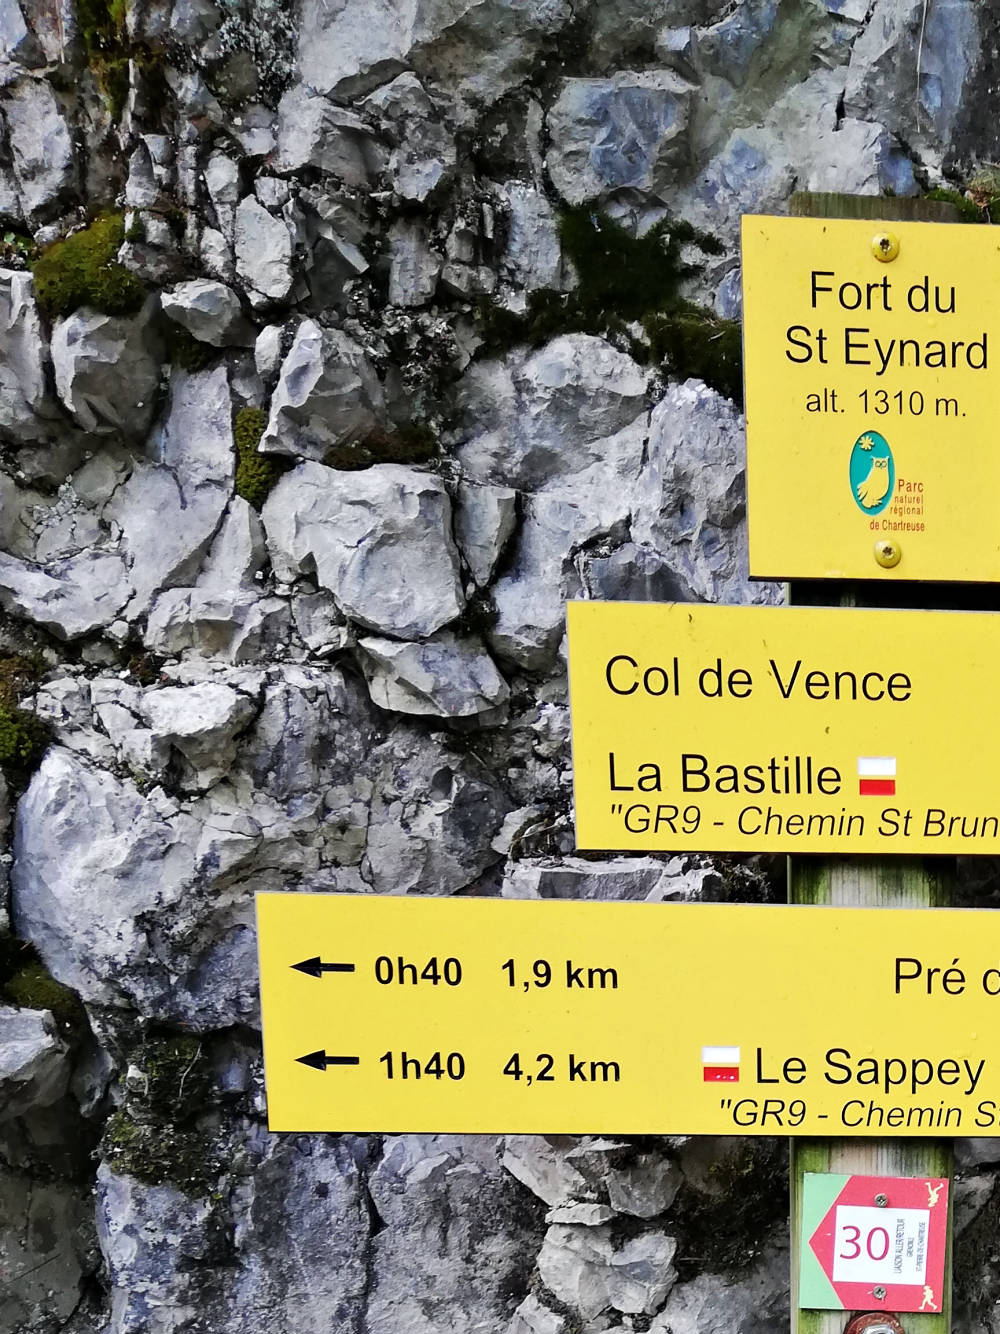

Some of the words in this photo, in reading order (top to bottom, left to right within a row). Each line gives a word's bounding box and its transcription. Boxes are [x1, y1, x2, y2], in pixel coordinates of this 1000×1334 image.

[811, 270, 893, 312] Fort
[907, 275, 956, 314] du
[785, 325, 828, 364] St
[844, 327, 988, 377] Eynard
[806, 387, 845, 414] alt.
[858, 389, 924, 416] 1310
[935, 398, 967, 417] m.
[894, 494, 924, 504] naturel
[897, 479, 924, 493] Parc
[869, 519, 880, 531] de
[881, 519, 925, 532] Chartreuse
[890, 505, 924, 517] régional
[605, 654, 680, 697] Col
[698, 658, 753, 699] de
[769, 659, 912, 702] Vence
[609, 752, 662, 793] La
[681, 753, 842, 795] Bastille
[611, 803, 701, 834] "GR9
[738, 805, 865, 837] Chemin
[878, 808, 913, 837] St
[374, 955, 462, 987] 0h40
[501, 958, 552, 993] 1,9
[566, 959, 618, 989] km
[895, 957, 966, 995] Pré
[379, 1051, 466, 1081] 1h40
[502, 1052, 555, 1087] 4,2
[568, 1053, 621, 1082] km
[756, 1047, 807, 1085] Le
[824, 1047, 986, 1096] Sappey
[720, 1098, 807, 1127] "GR9
[841, 1099, 962, 1128] Chemin
[840, 1225, 890, 1261] 30
